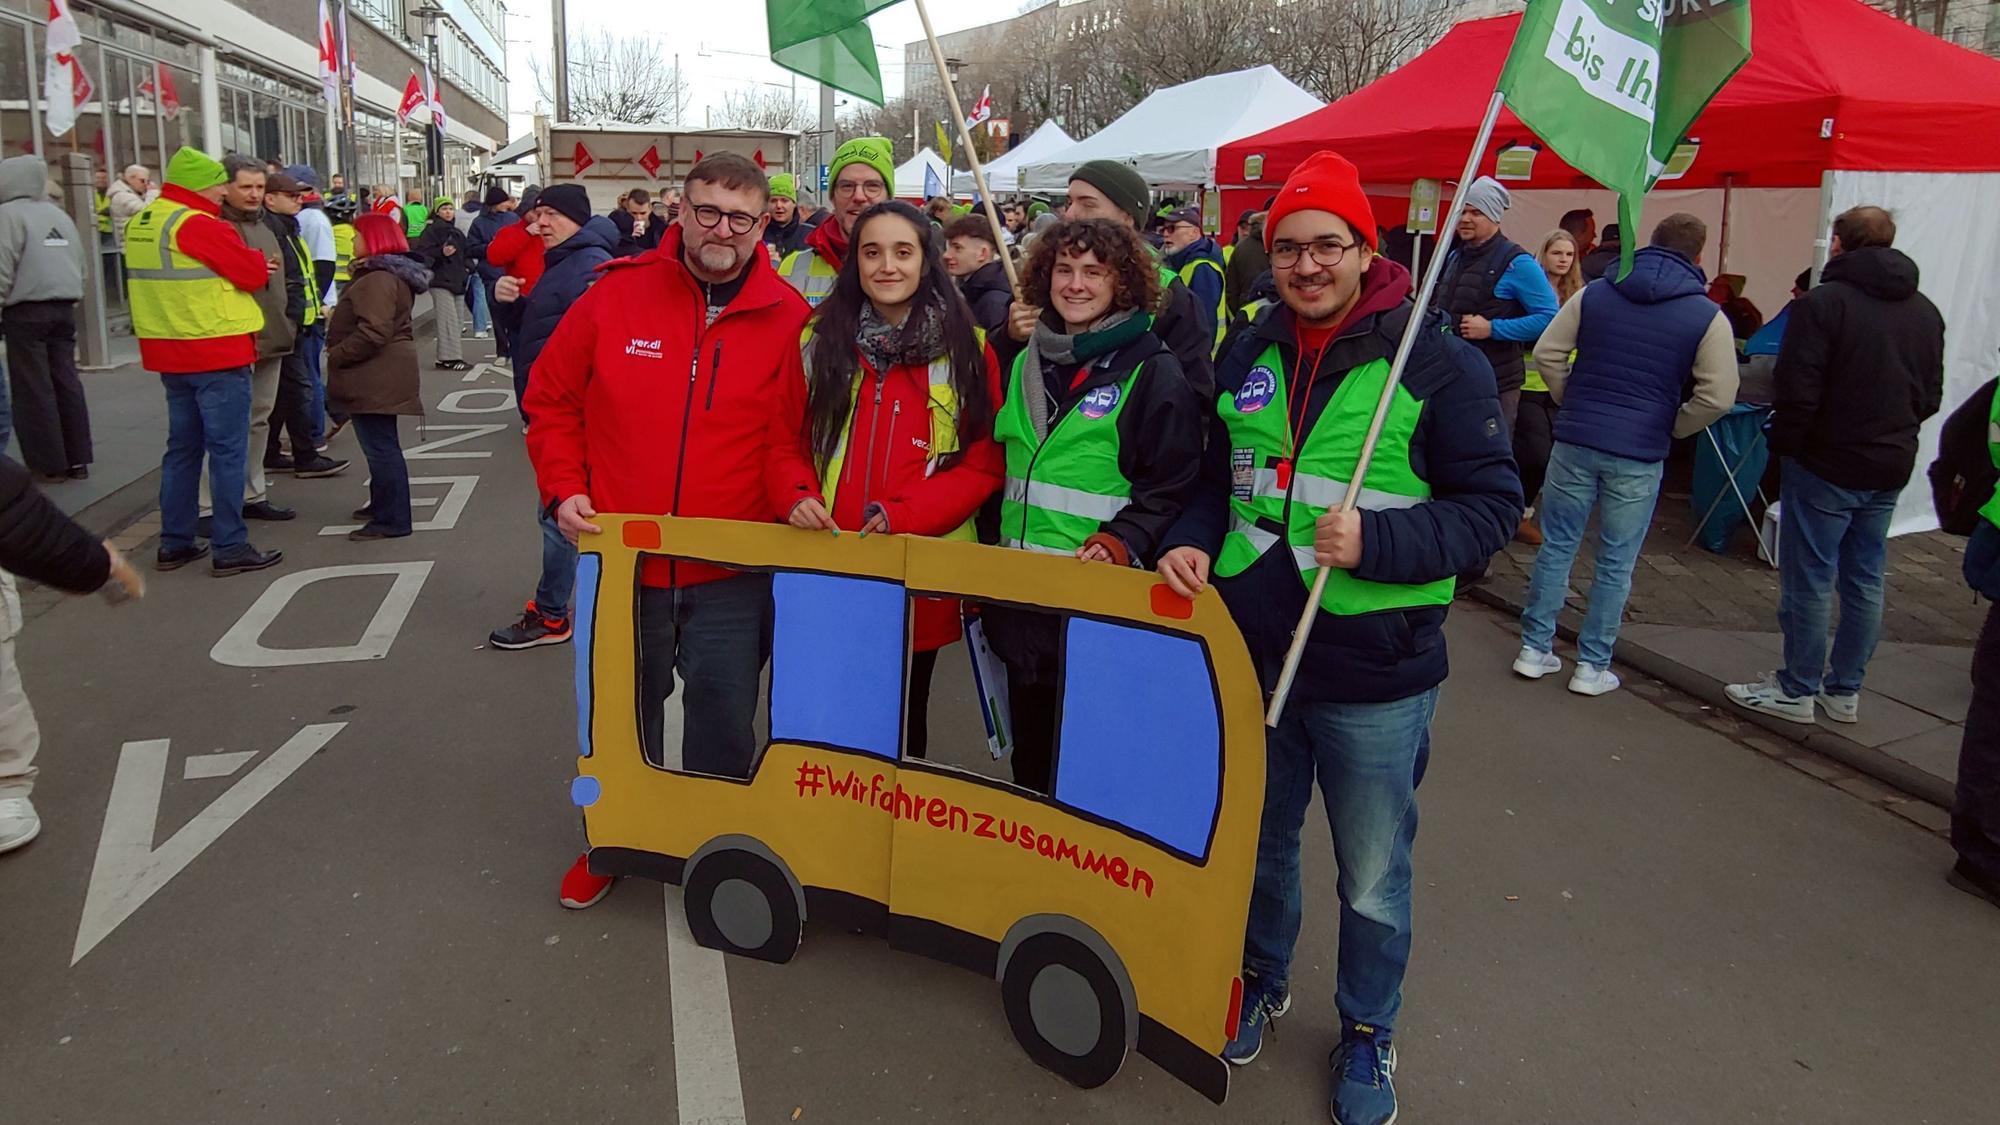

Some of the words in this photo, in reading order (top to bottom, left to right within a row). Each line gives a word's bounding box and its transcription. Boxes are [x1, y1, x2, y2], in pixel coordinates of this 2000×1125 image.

[1563, 15, 1605, 82] bis
[1615, 56, 1656, 110] Ih
[631, 338, 662, 350] ver.di
[911, 437, 930, 451] ver.
[794, 760, 1154, 899] #Wirfahrenzusammen
